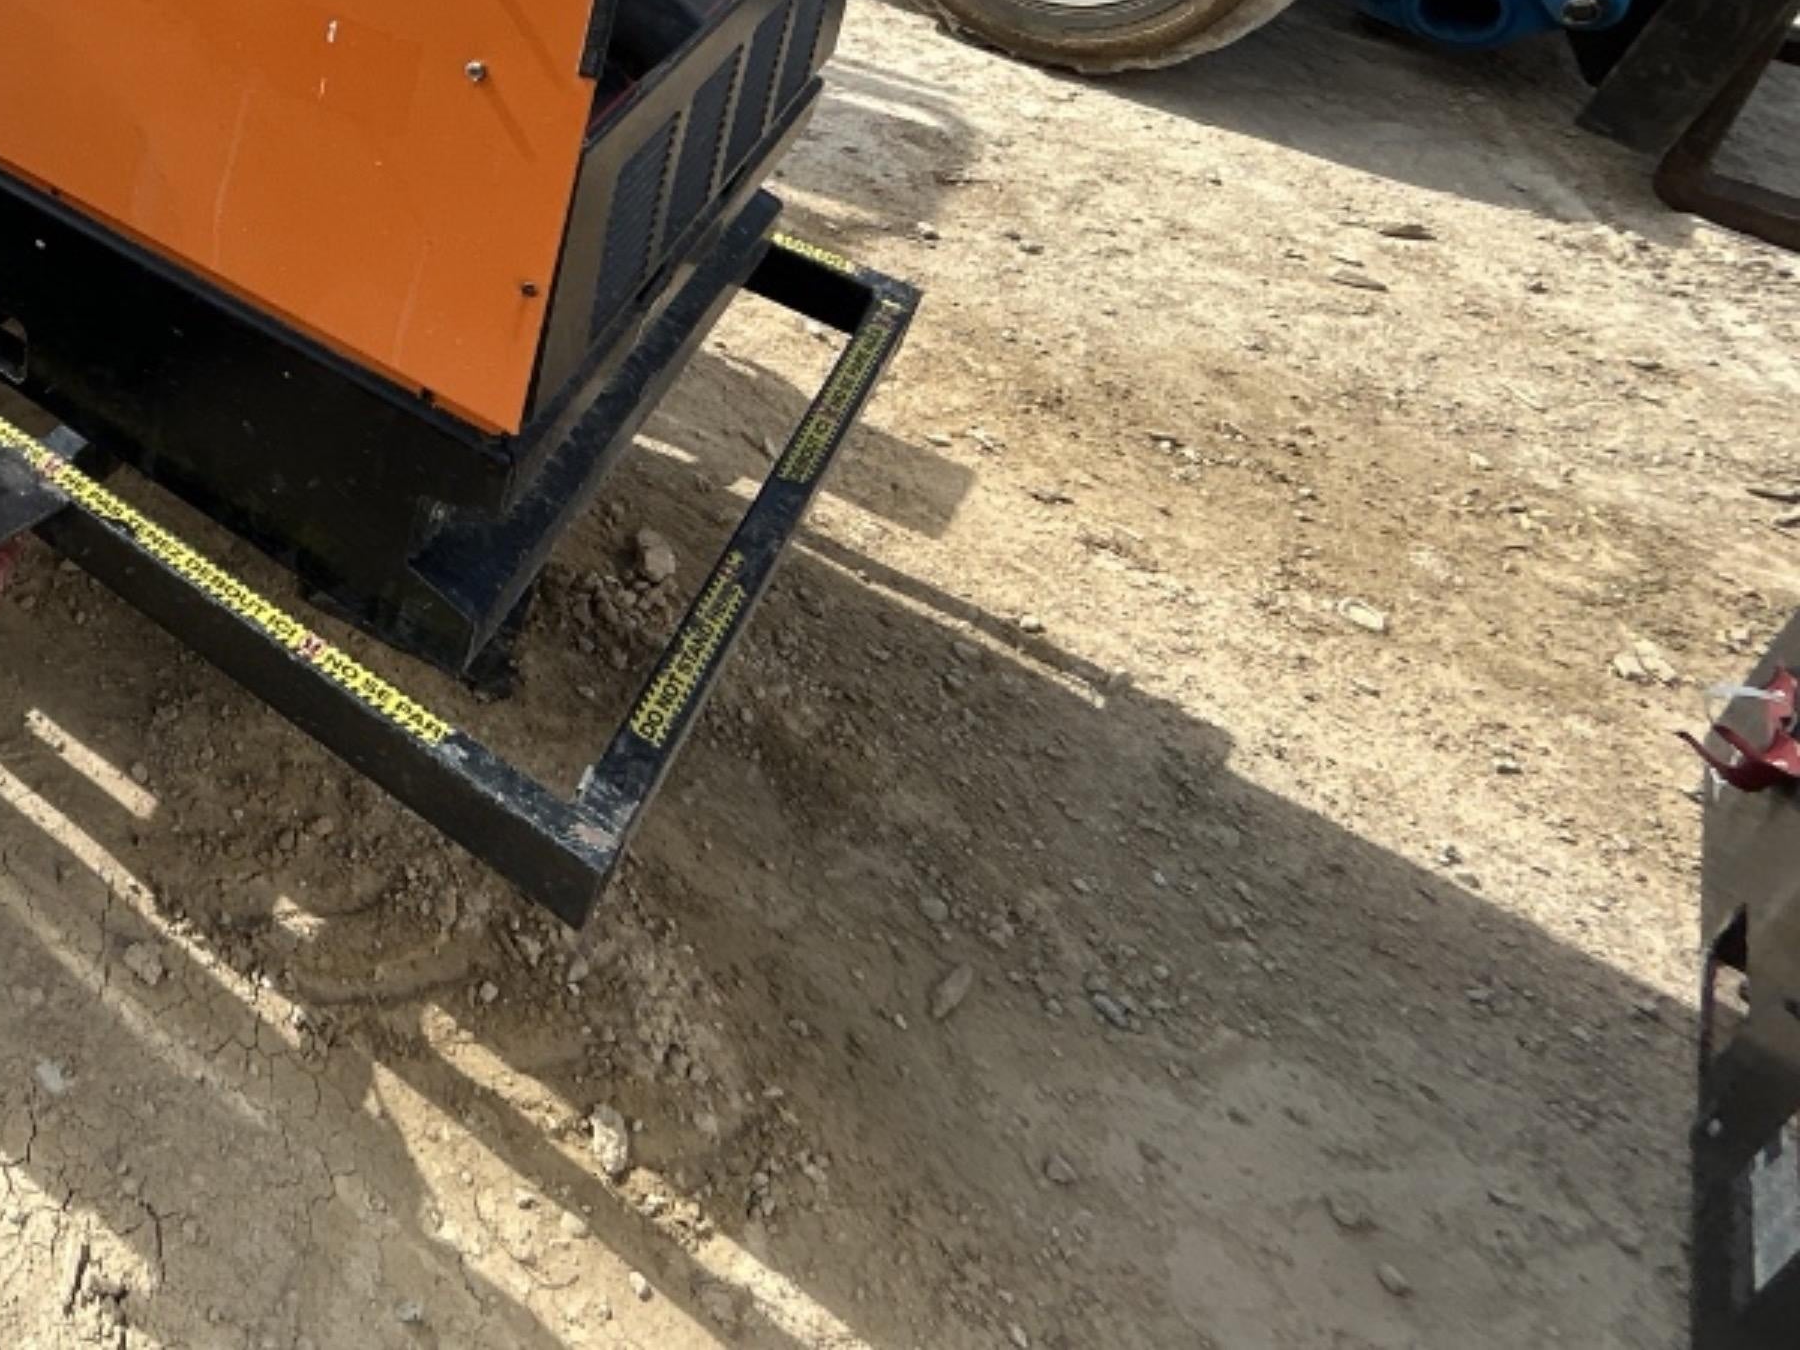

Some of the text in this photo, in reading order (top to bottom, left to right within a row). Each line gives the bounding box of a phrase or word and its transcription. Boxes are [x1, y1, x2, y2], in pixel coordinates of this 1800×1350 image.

[186, 556, 268, 617] DEBOUT
[325, 652, 358, 679] NO
[362, 677, 393, 703] SE
[638, 710, 664, 739] DO
[656, 672, 688, 712] NOT
